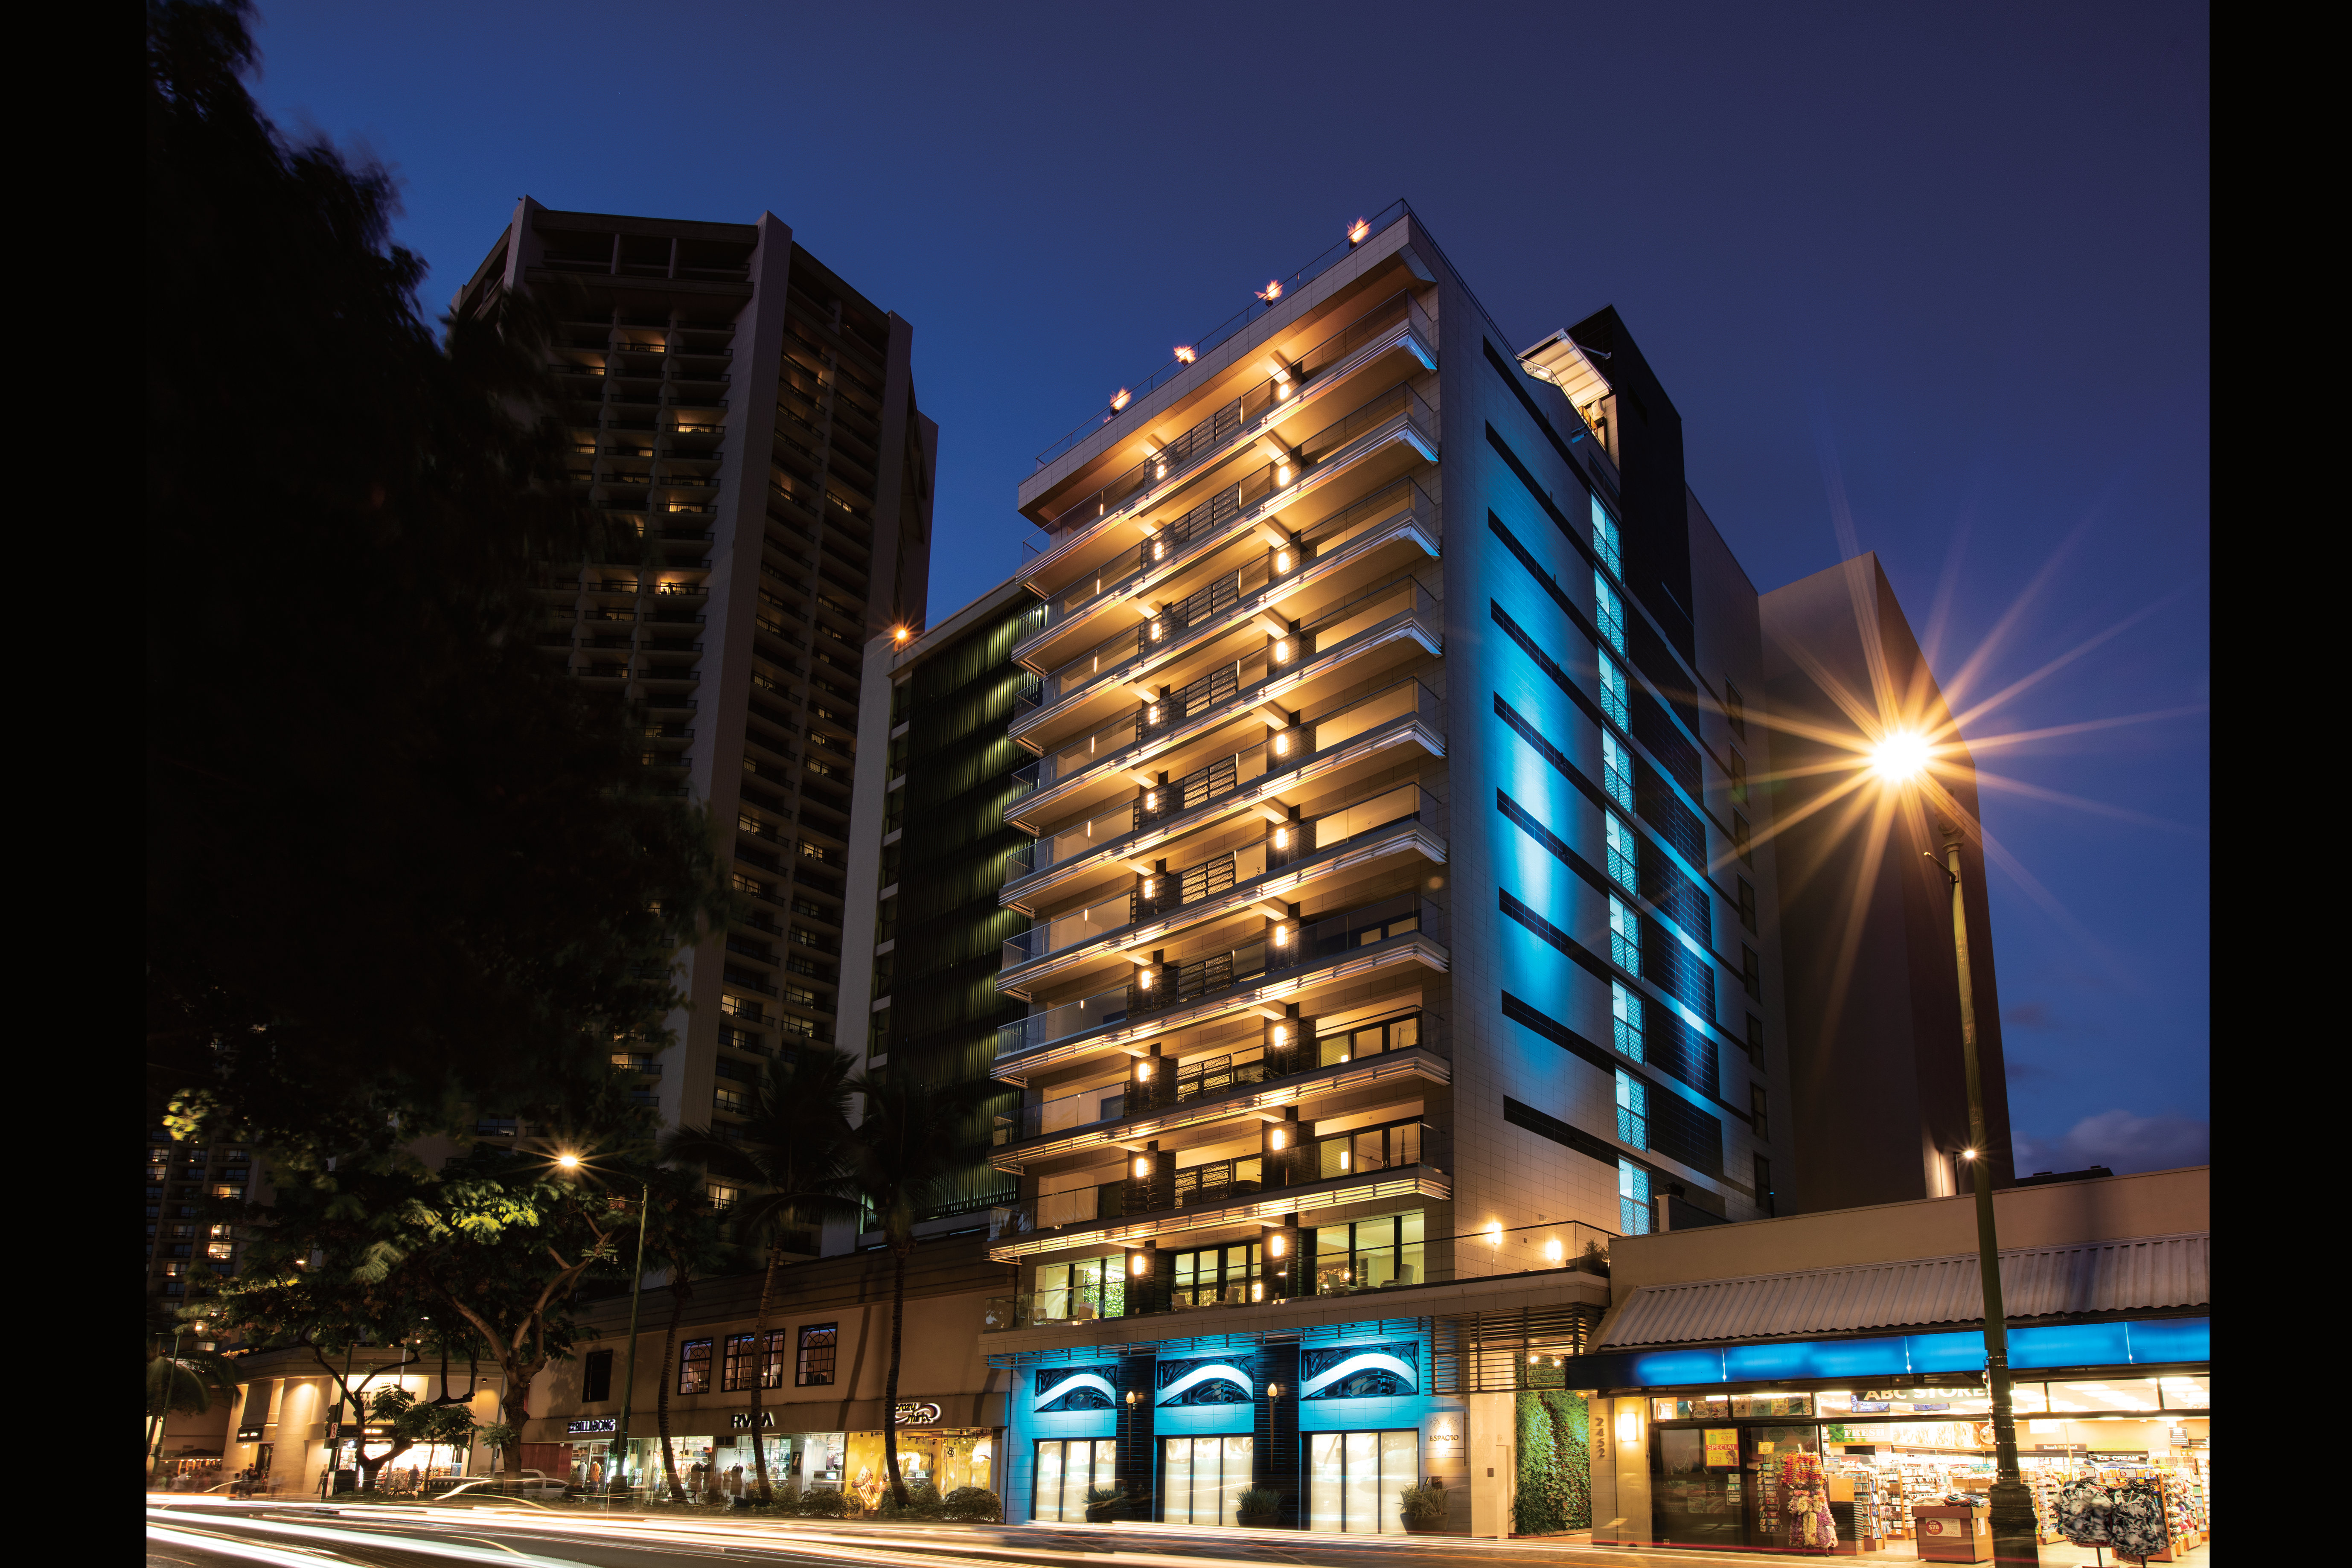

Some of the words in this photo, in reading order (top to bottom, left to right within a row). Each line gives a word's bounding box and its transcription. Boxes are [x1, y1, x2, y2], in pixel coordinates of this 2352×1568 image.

[1863, 1390, 1907, 1401] ABC
[1913, 1388, 1989, 1399] STORE
[575, 1420, 615, 1432] BILLABONG
[731, 1412, 774, 1428] RVA
[1596, 1418, 1605, 1457] 2452
[1707, 1480, 1716, 1497] deli
